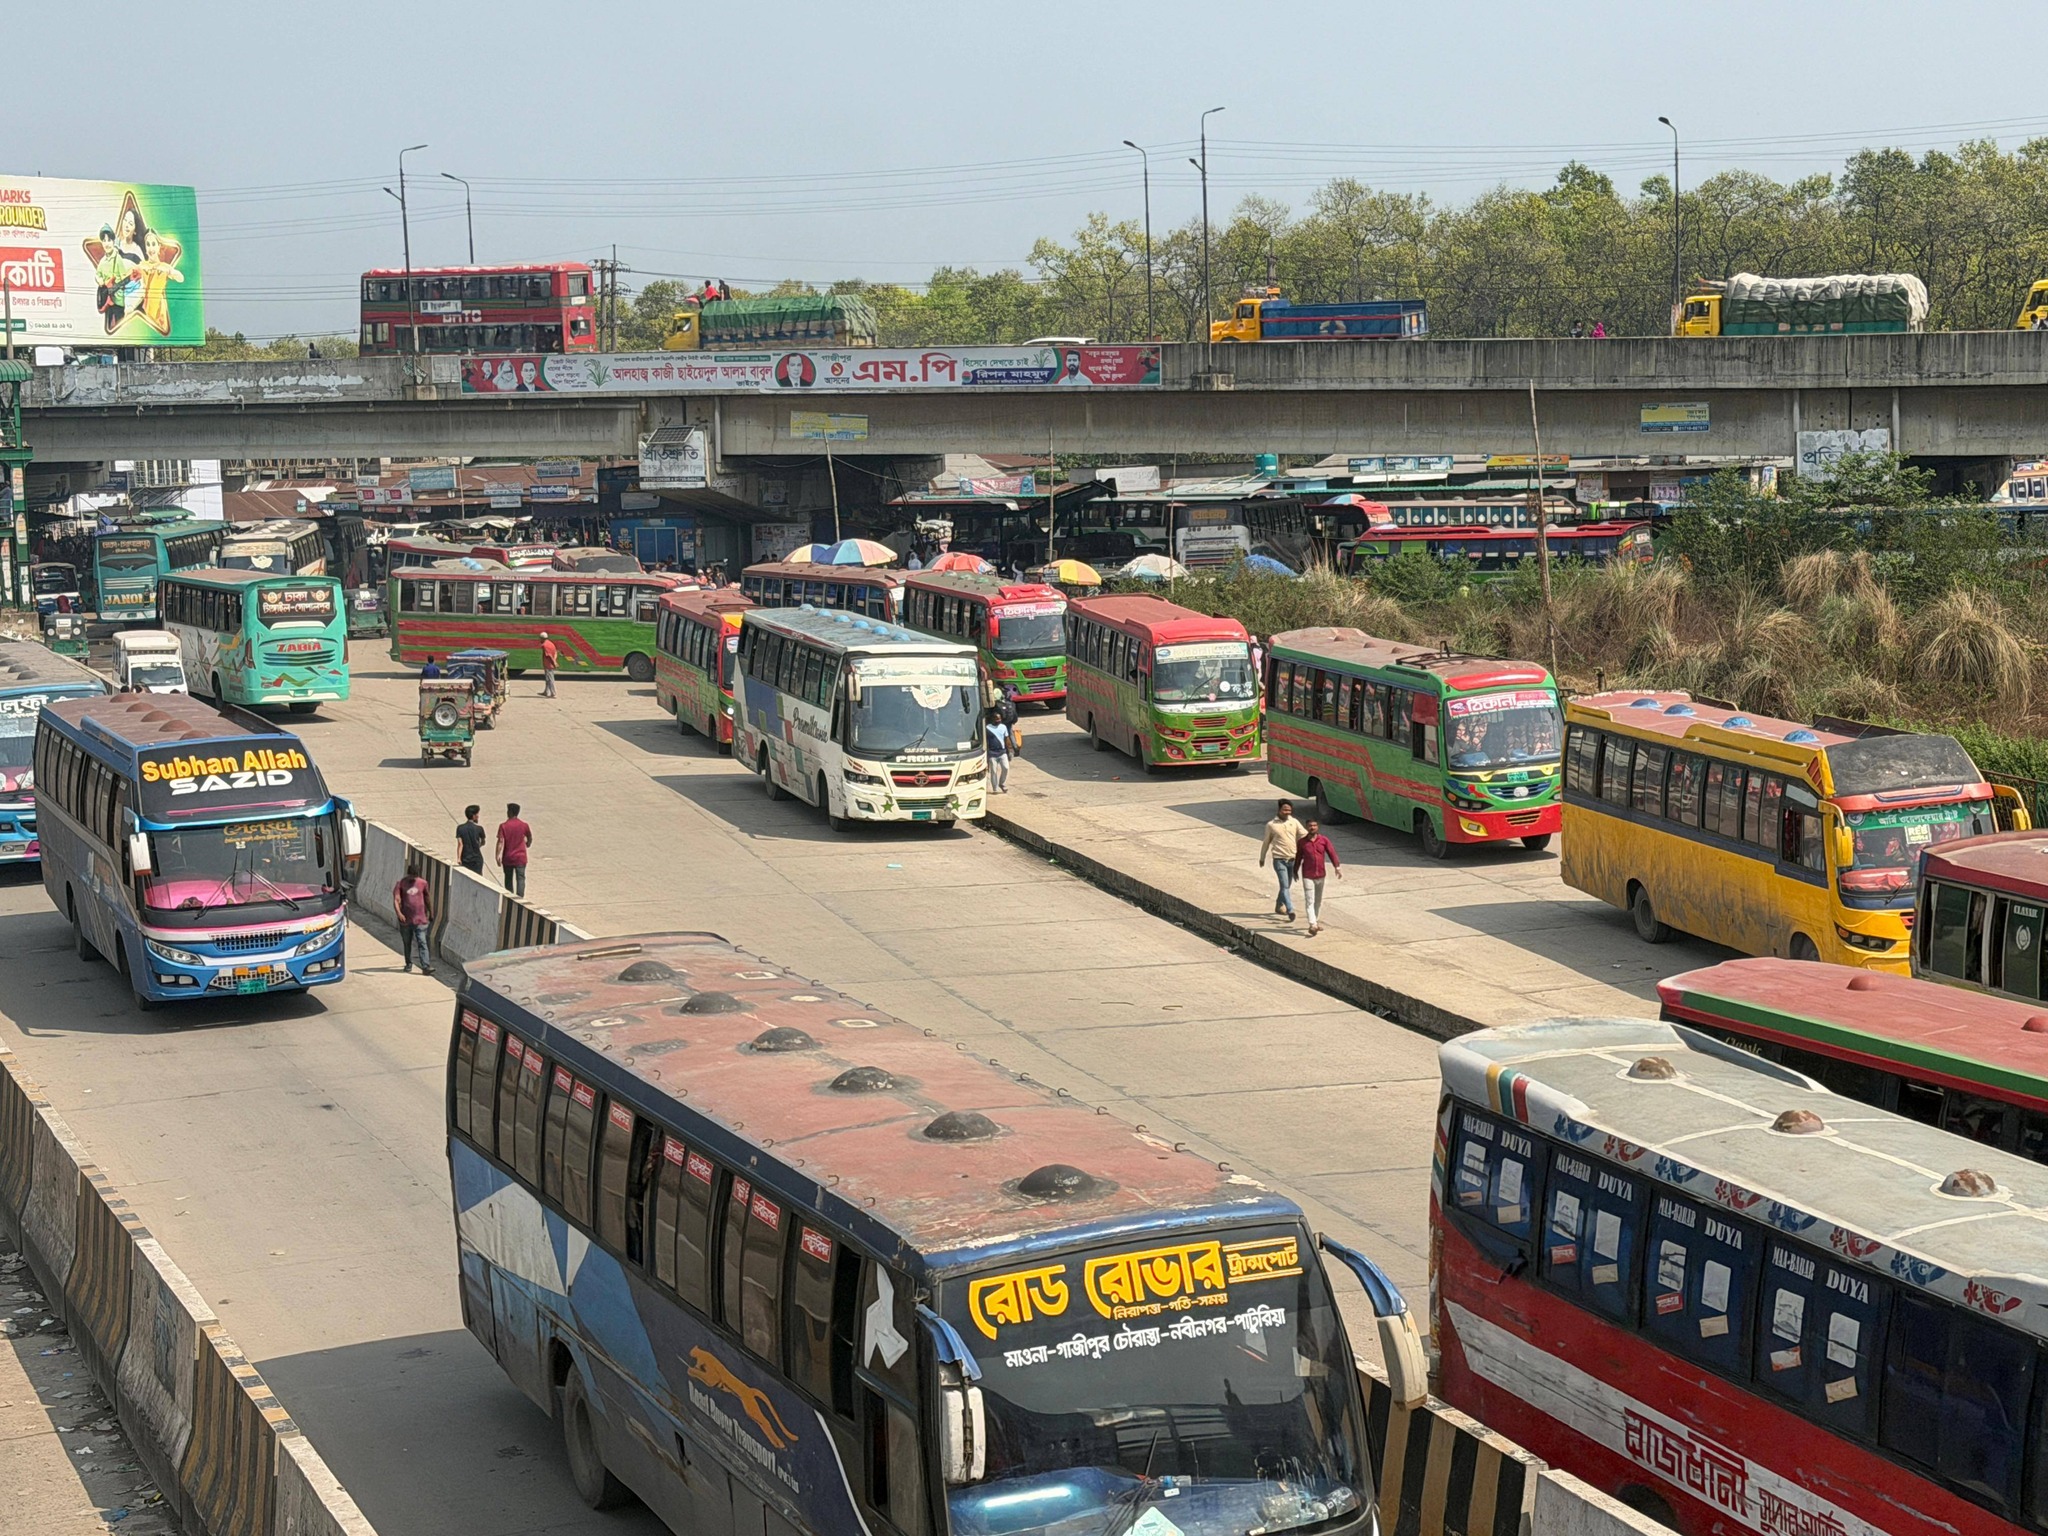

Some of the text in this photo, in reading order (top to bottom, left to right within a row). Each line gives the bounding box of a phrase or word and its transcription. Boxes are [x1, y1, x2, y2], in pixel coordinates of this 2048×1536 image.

[821, 353, 851, 363] গাজীপুর
[852, 352, 957, 382] এম.পি
[963, 358, 1029, 367] হিসেবে দেখতে চাই
[651, 362, 674, 381] কাজী
[721, 366, 746, 380] আলম
[750, 366, 773, 383] বাবুল
[976, 370, 1049, 379] রিপন মাহমুদ
[284, 591, 308, 602] ঢাকা
[1467, 694, 1516, 712] ঠিকানা
[141, 749, 308, 782] Subhan Allah
[896, 755, 948, 763] PROMIT
[169, 770, 293, 796] SAZID
[2013, 905, 2039, 919] CLASSIC
[1501, 1132, 1532, 1159] DUYA
[1597, 1171, 1633, 1201] DUYA
[1704, 1217, 1743, 1250] DUYA
[968, 1240, 1226, 1341] রোড রোভার
[1826, 1269, 1870, 1304] DUYA
[1113, 1293, 1228, 1321] নিরাপত্তা-গতি-সময়
[1004, 1304, 1286, 1369] মাওনা-গাজীপুর চৌরাস্তা-নবীনগর-পাটুরিয়া
